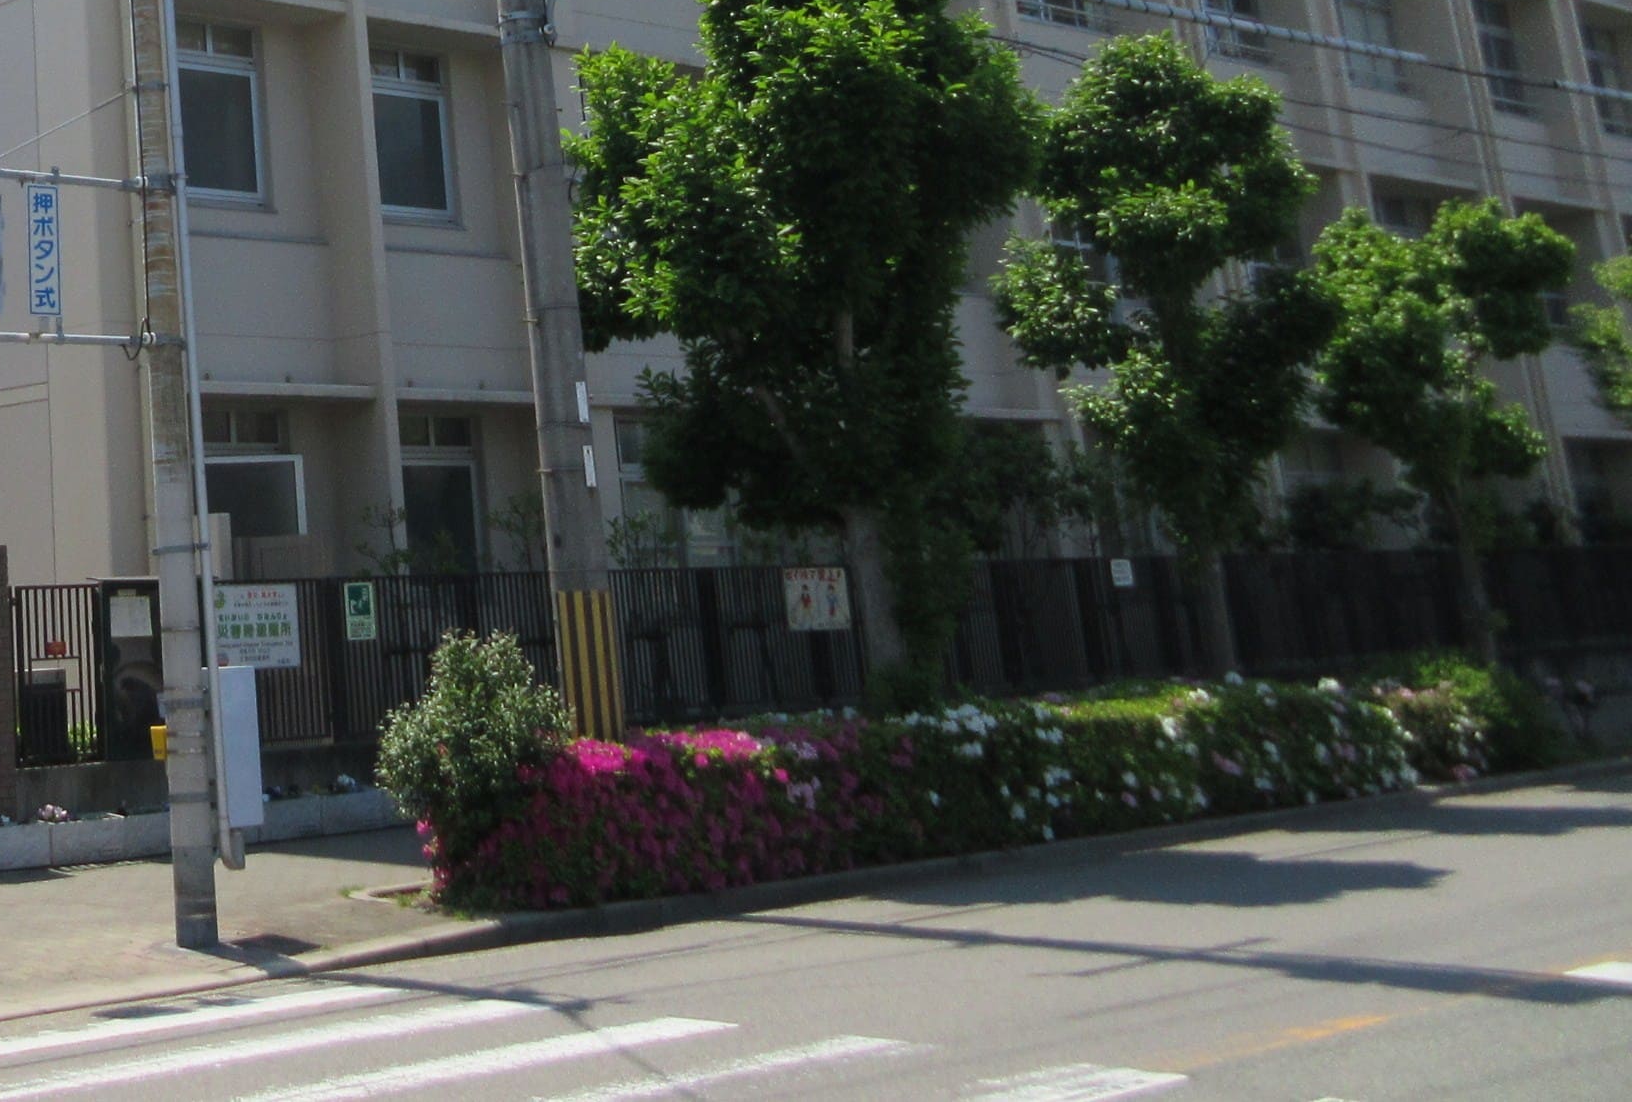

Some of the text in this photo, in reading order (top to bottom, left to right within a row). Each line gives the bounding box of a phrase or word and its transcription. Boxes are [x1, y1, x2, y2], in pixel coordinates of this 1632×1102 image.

[32, 192, 56, 309] 押ボタン式
